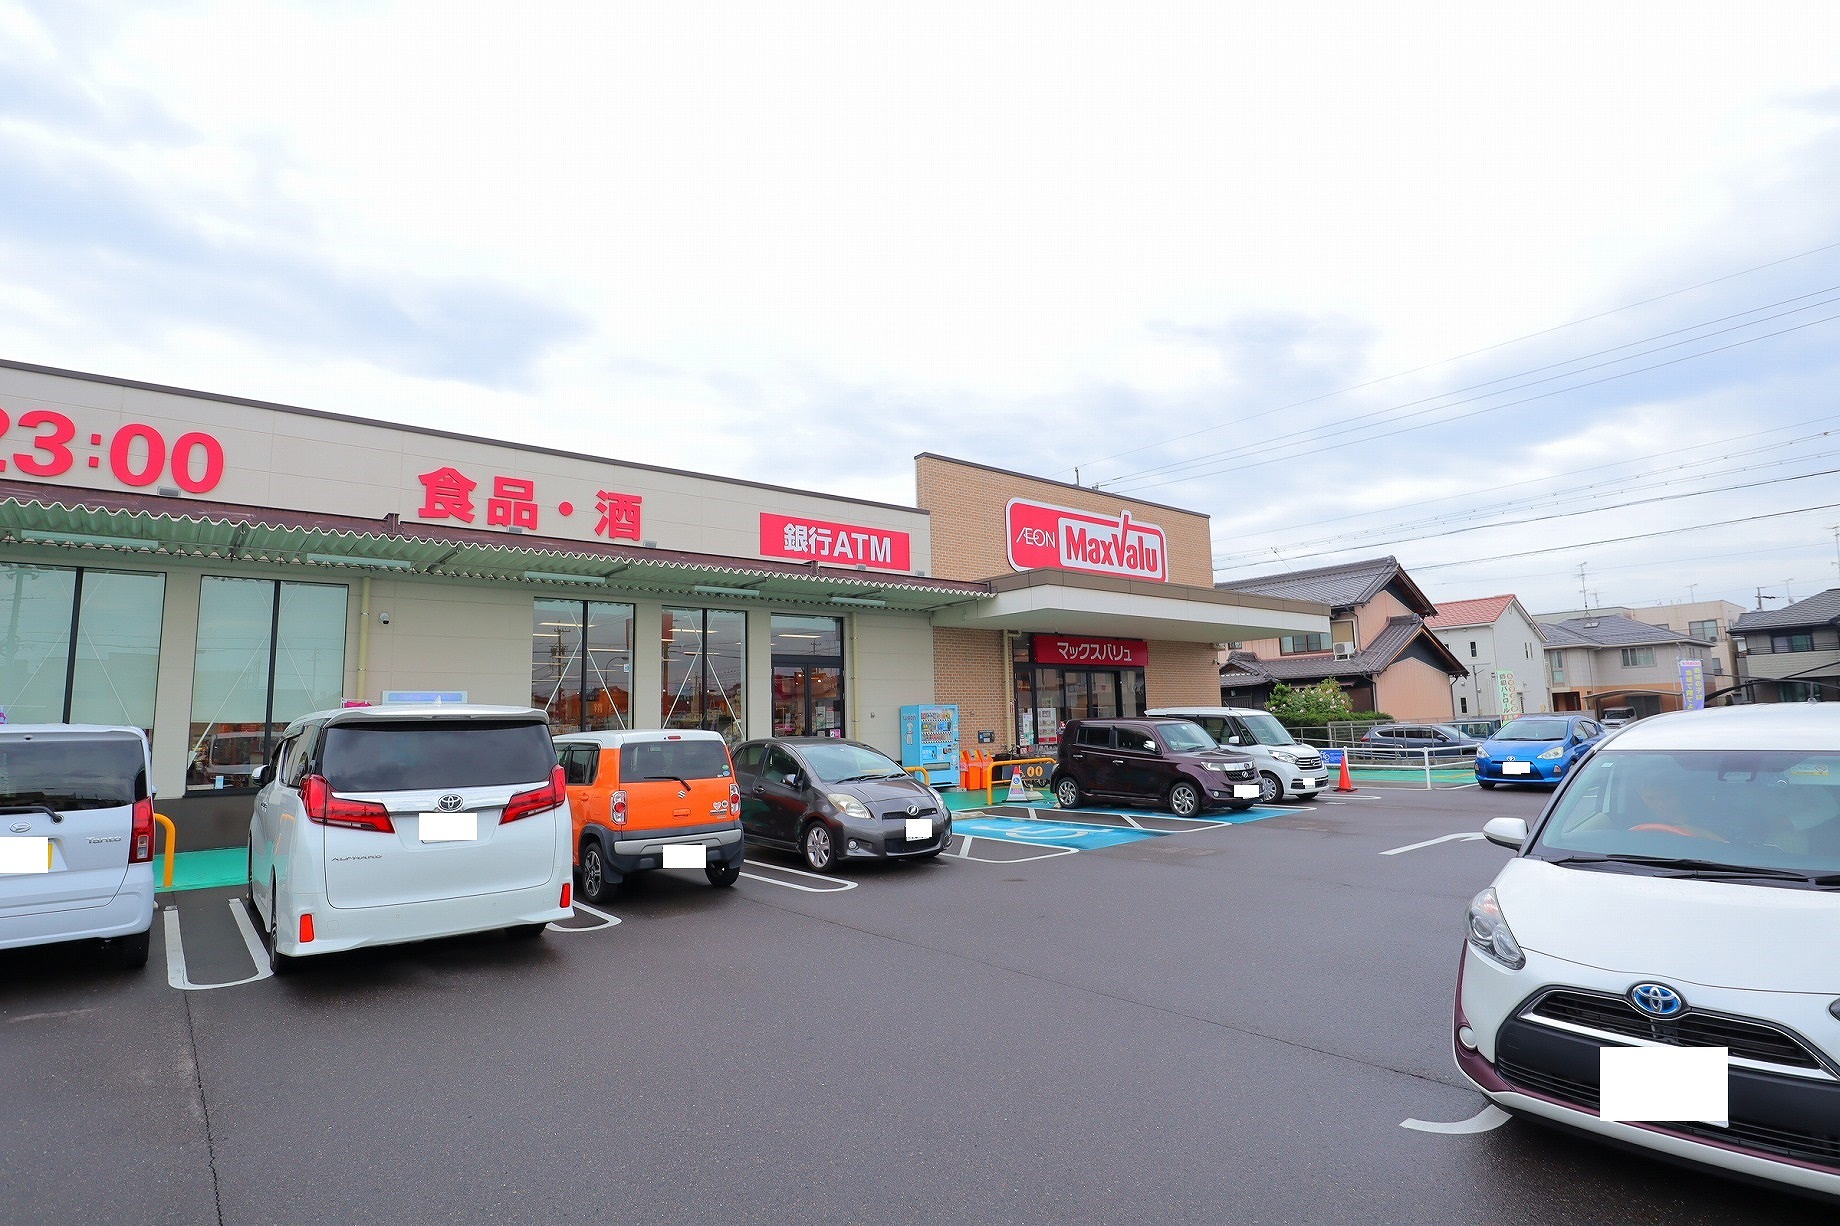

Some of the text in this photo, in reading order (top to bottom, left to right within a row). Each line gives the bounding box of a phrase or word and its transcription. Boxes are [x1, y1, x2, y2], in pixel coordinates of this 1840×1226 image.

[0, 408, 224, 494] 3:00
[418, 467, 643, 541] 食品・酒
[784, 523, 891, 563] 銀行ATM
[1065, 515, 1157, 573] MaxValu
[1057, 642, 1132, 661] マックスバリュ
